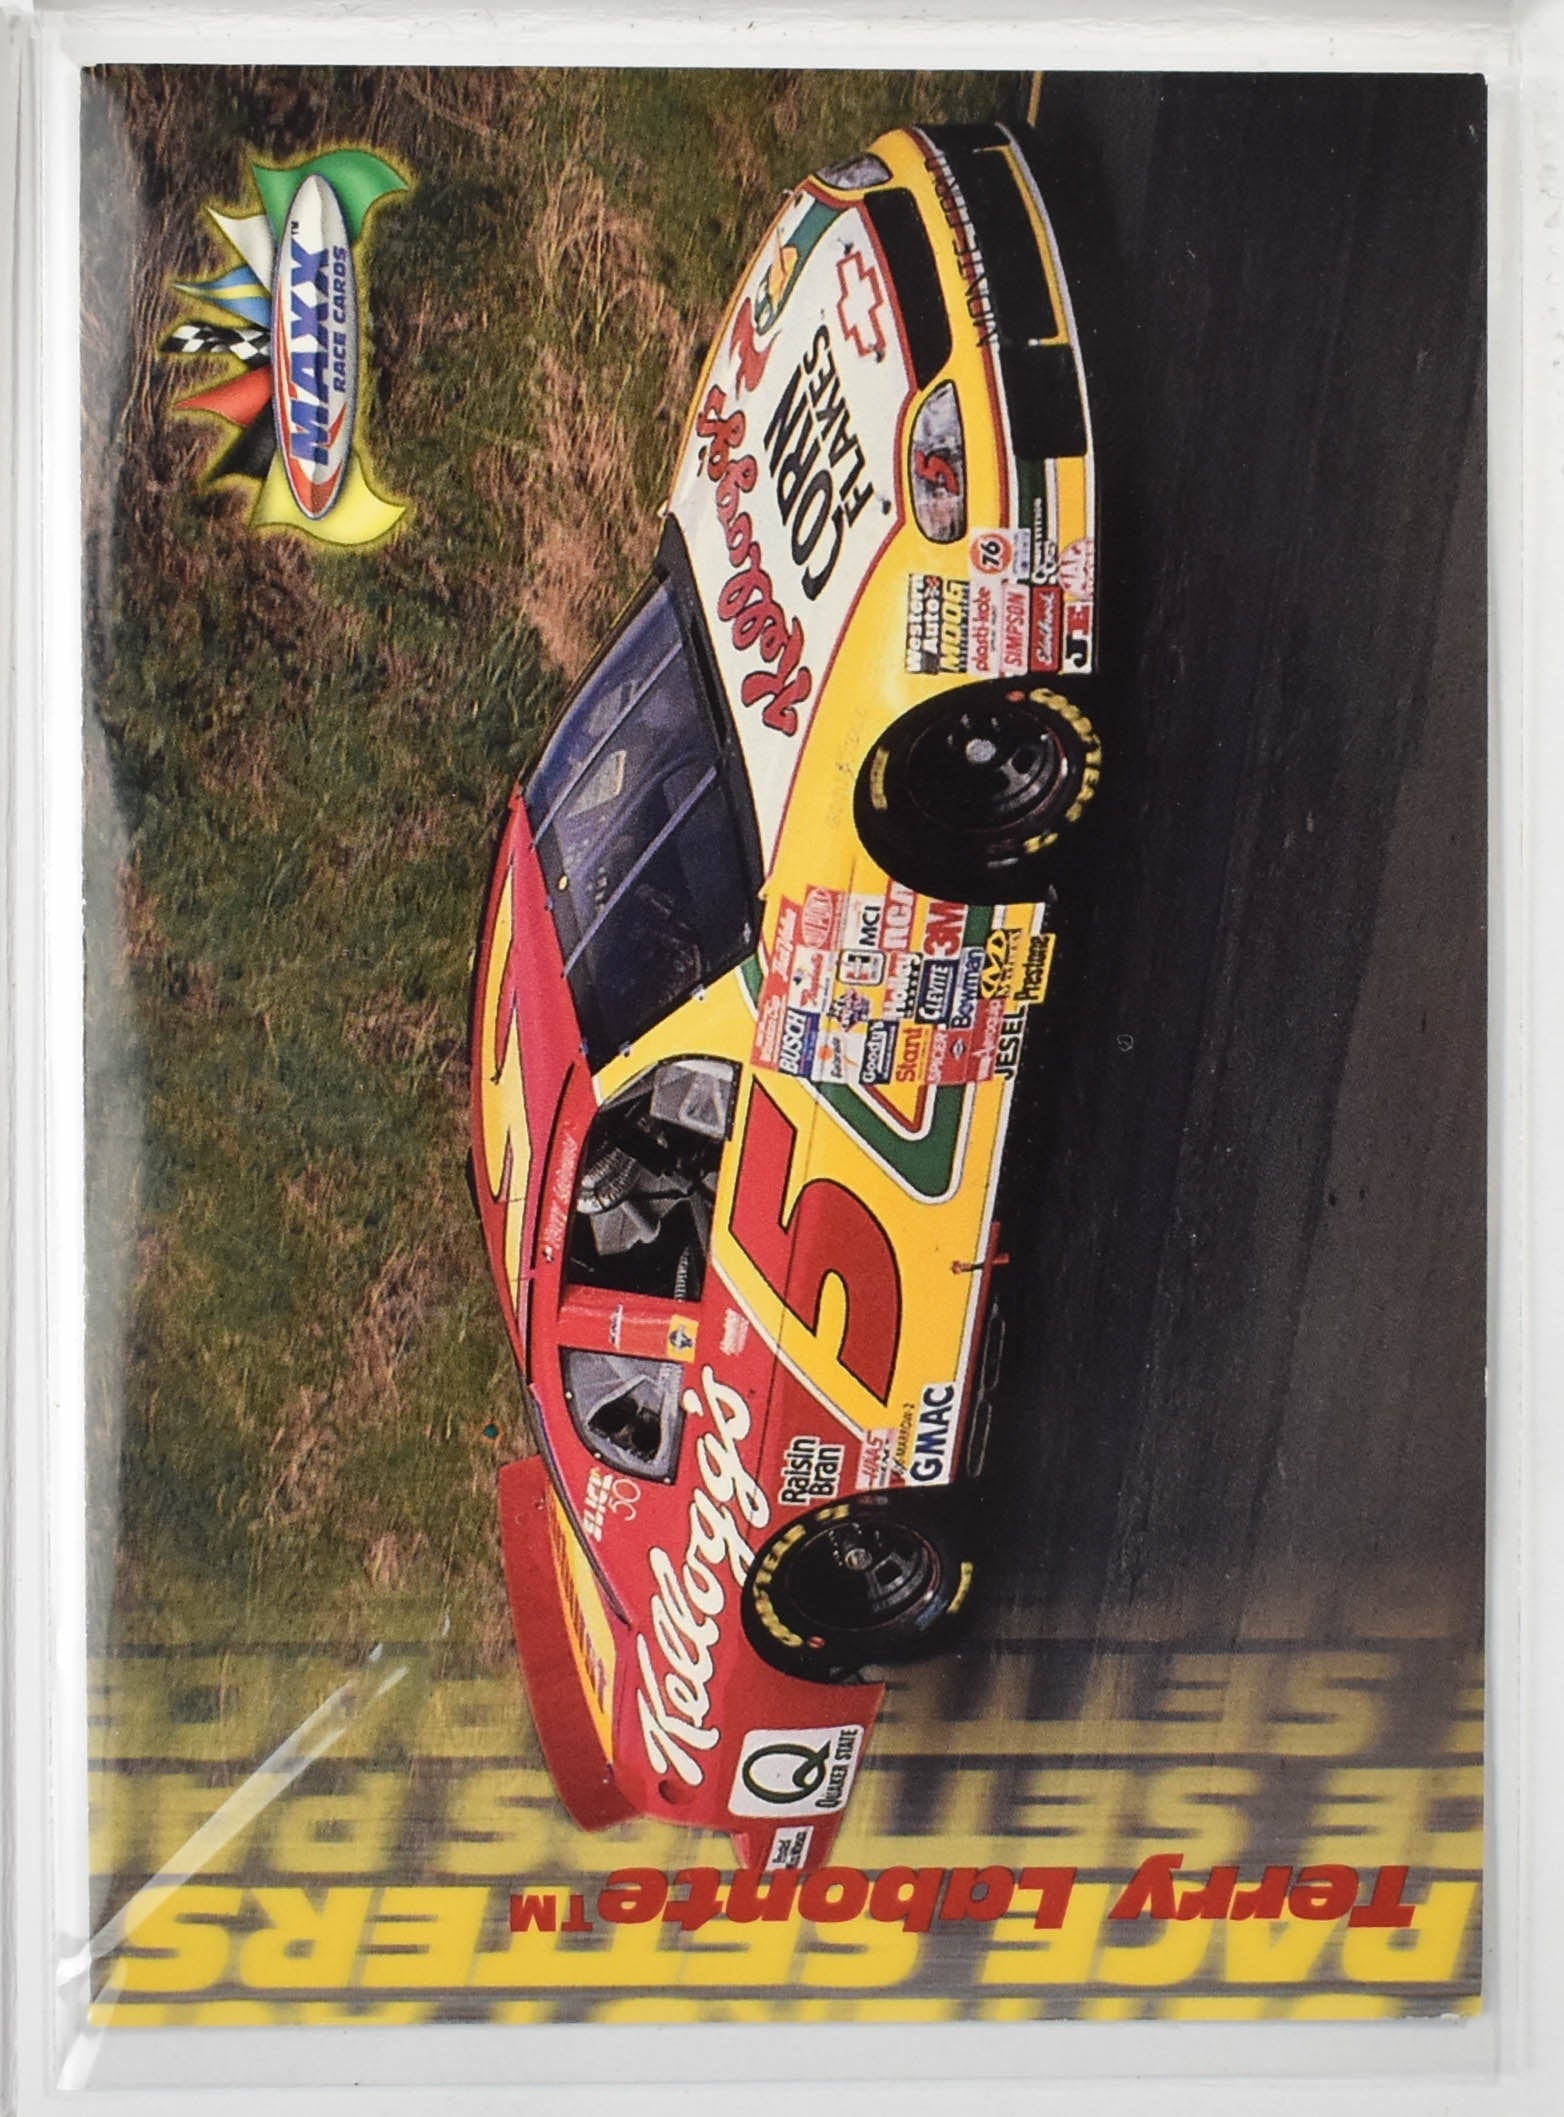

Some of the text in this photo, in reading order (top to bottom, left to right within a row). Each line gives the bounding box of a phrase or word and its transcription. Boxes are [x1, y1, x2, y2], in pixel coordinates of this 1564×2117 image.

[333, 246, 347, 393] RACE CARDS
[803, 324, 874, 524] FLAKES
[762, 365, 845, 602] CORN
[915, 451, 960, 494] 5
[694, 384, 812, 736] Kellogg's
[980, 540, 1000, 566] 76
[906, 574, 924, 672] Western
[923, 598, 940, 654] Auto
[940, 581, 963, 671] MOOG
[972, 586, 991, 671] plasti-kote
[1003, 592, 1026, 667] SIMPSON
[1065, 604, 1090, 667] JE
[858, 905, 881, 947] MCI
[923, 902, 966, 957] 3M
[917, 964, 949, 1020] CLEVITE
[951, 948, 986, 1030] Bowman
[1012, 934, 1051, 1001] Prestone
[779, 1010, 807, 1073] BUSCH
[861, 1020, 885, 1083] Goody's
[896, 1026, 923, 1083] Stant
[926, 1032, 949, 1083] SPICER
[994, 1004, 1026, 1081] JESEL
[481, 867, 532, 1315] 5
[728, 1074, 902, 1407] 5
[909, 1385, 954, 1482] GMAC
[583, 1467, 613, 1542] SLICK
[610, 1478, 641, 1521] 50
[781, 1438, 817, 1503] Raisin
[808, 1447, 841, 1496] Bran
[637, 1366, 771, 1786] Kellogg's
[741, 1739, 832, 1804] Q
[834, 1728, 858, 1761] STATE
[1107, 1853, 1416, 1930] Terry
[104, 1879, 1478, 1992] PACE SETTERS
